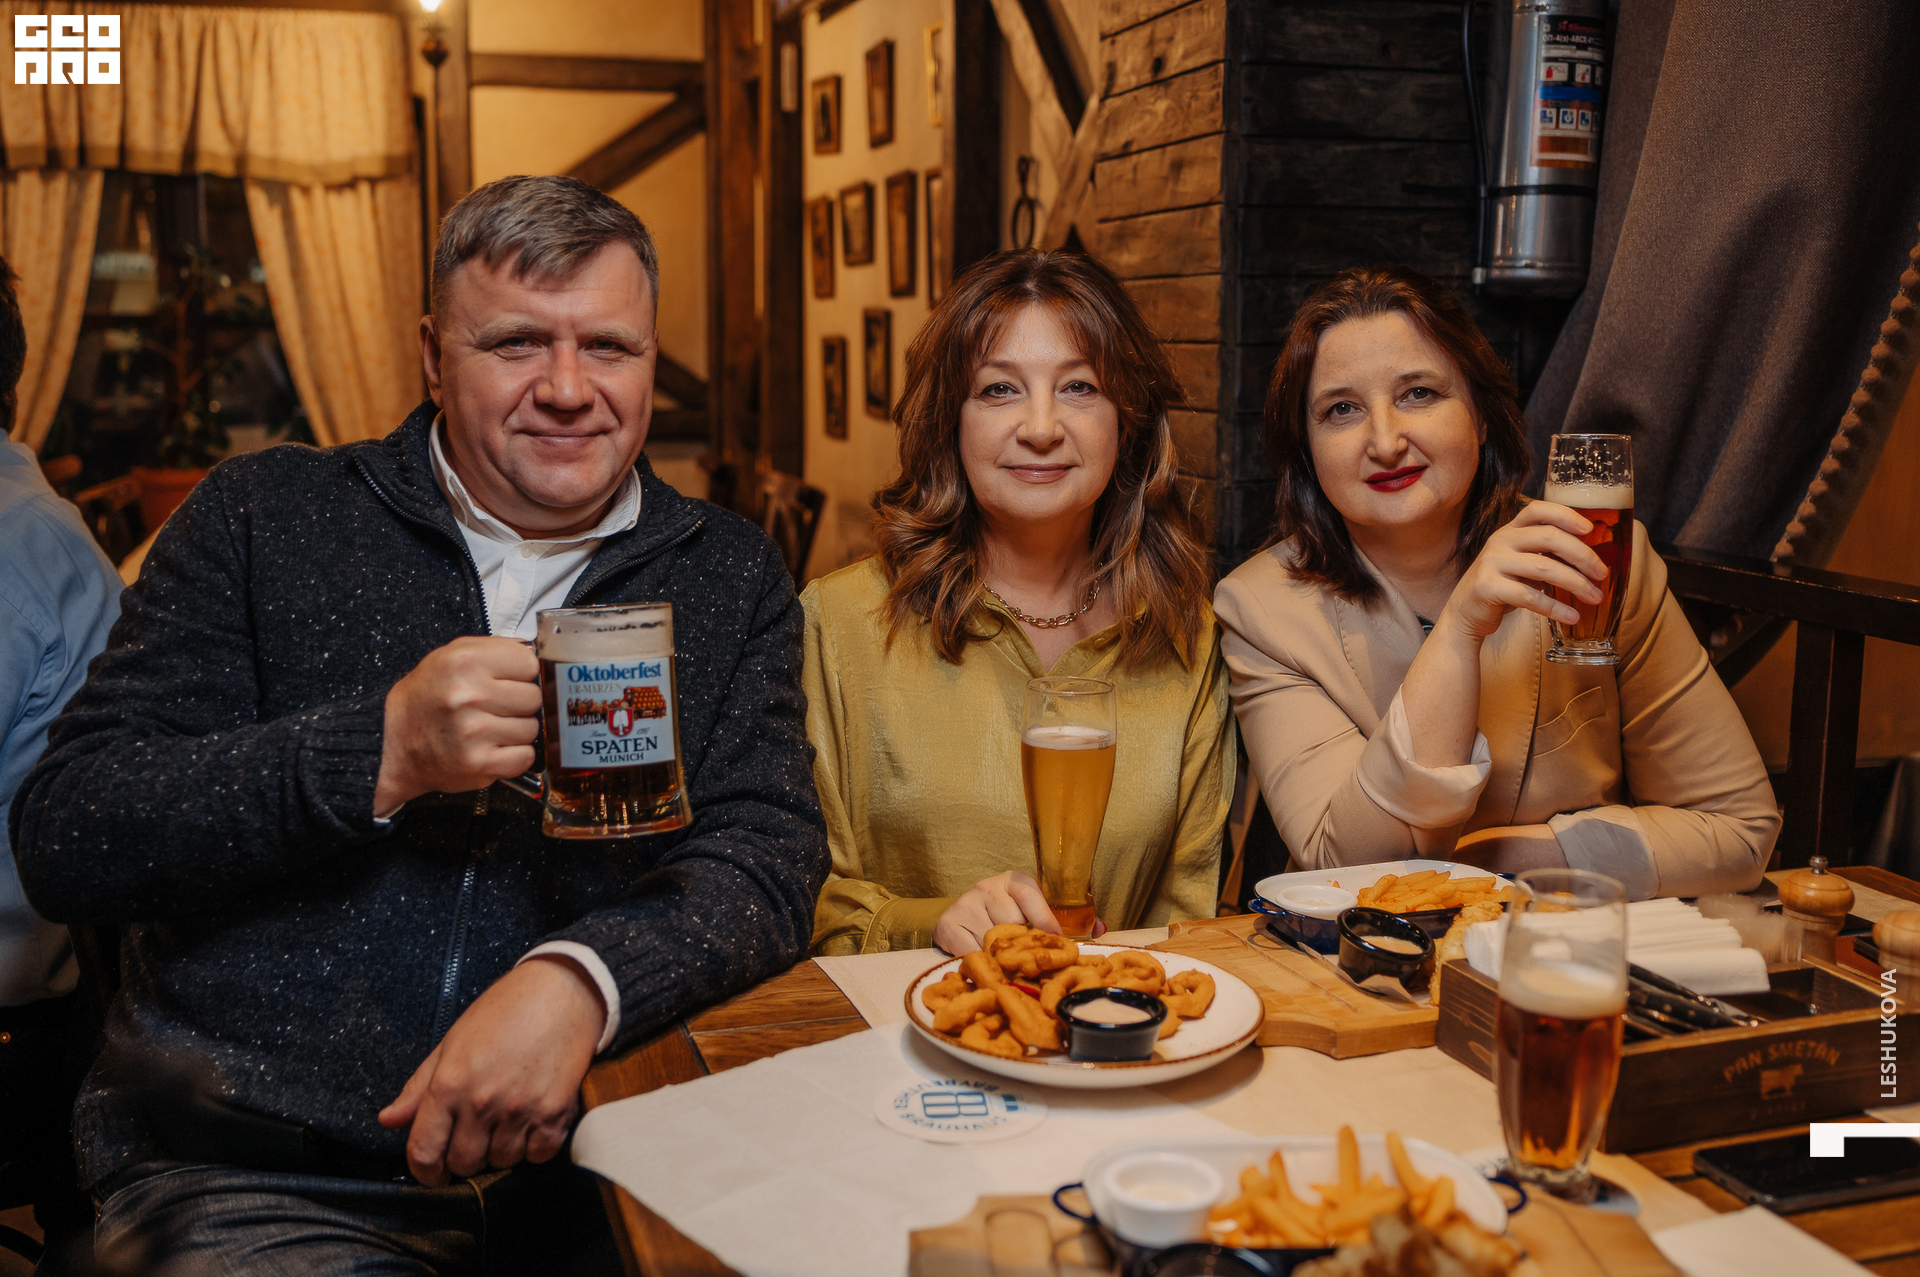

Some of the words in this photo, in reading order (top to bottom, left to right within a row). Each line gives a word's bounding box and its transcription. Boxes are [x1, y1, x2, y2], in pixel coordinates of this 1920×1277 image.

[568, 661, 662, 682] Oktoberfest
[581, 736, 658, 755] SPATEN
[600, 753, 645, 763] MUNICH
[1722, 1049, 1762, 1084] PAN
